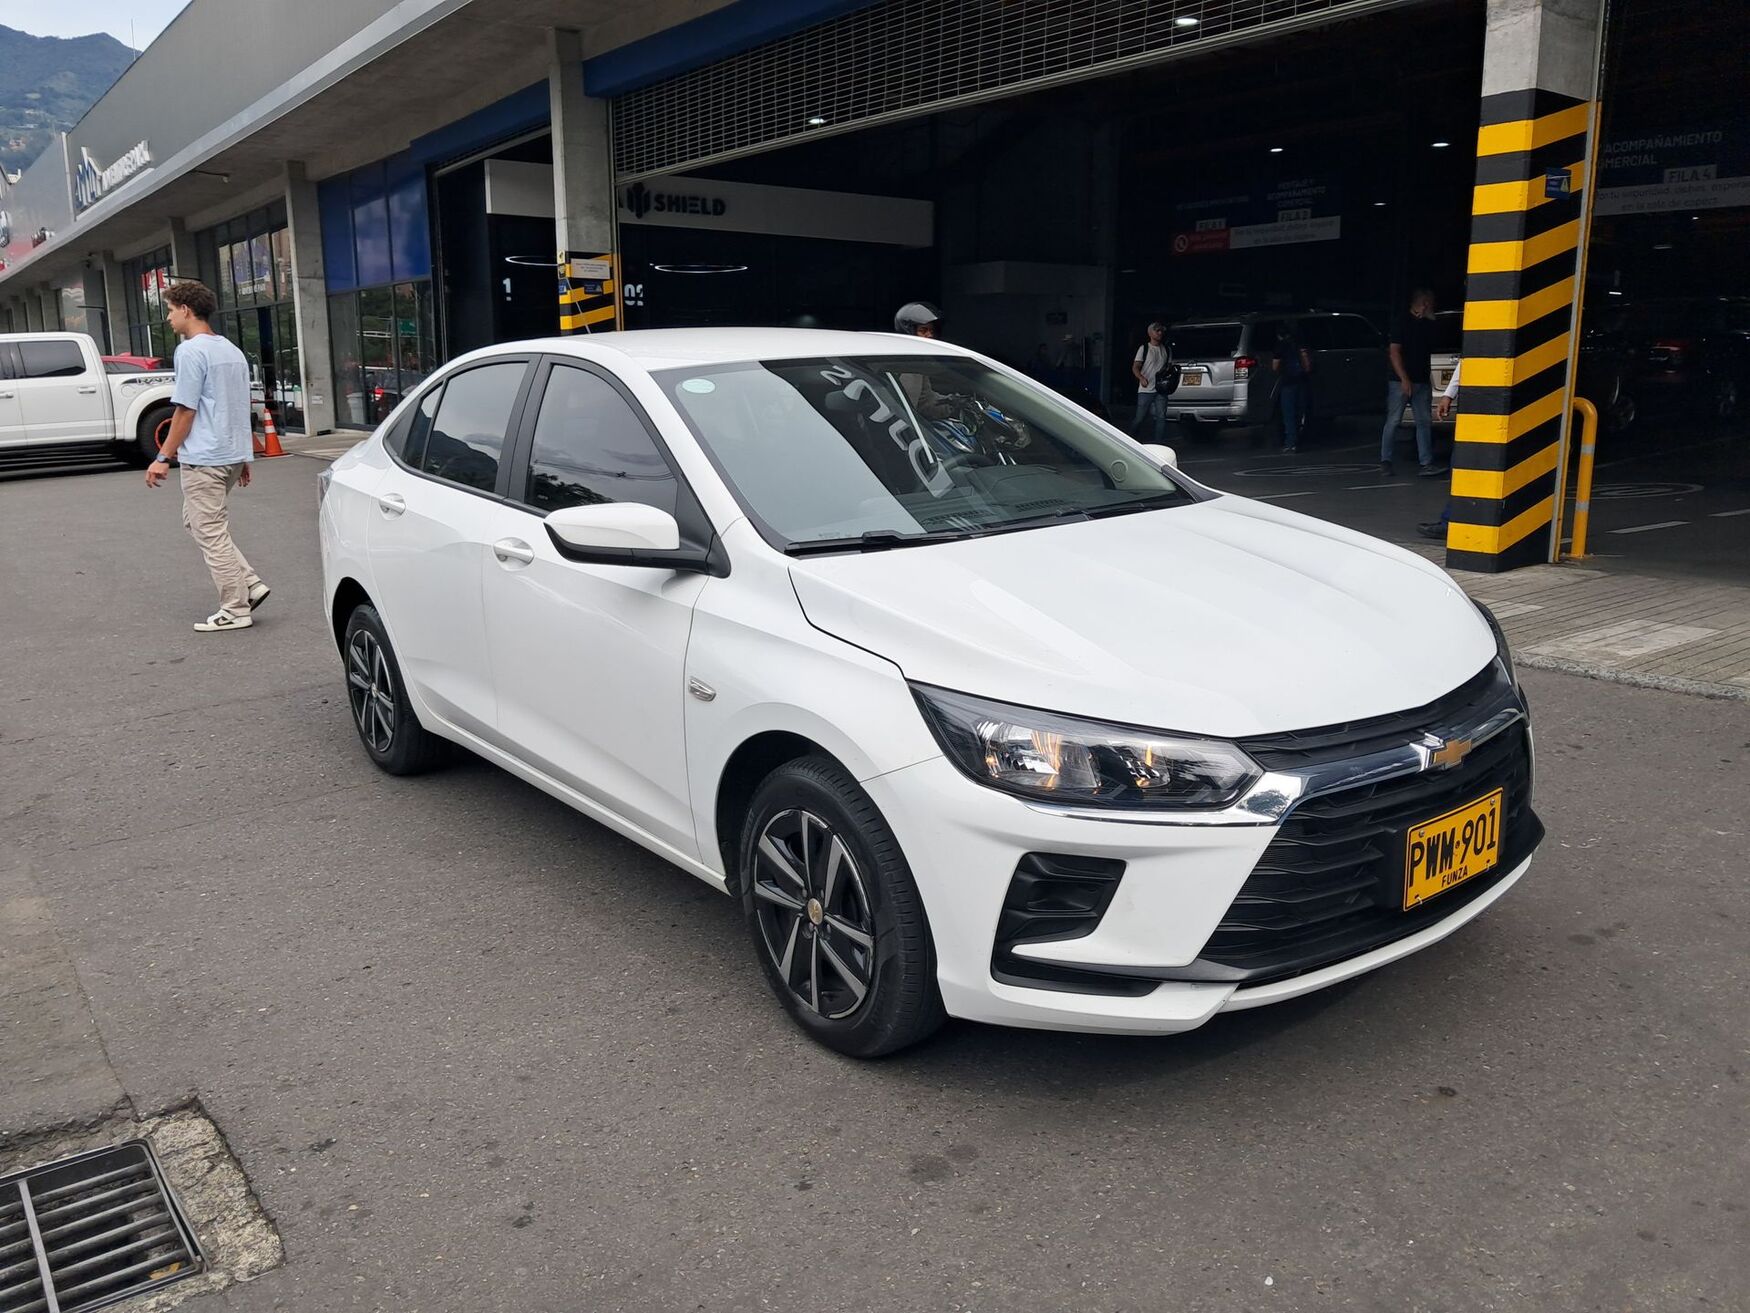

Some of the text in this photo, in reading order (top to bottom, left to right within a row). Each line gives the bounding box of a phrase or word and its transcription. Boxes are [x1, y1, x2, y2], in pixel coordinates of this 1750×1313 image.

[1669, 170, 1700, 183] FILA
[654, 194, 726, 216] SHIELD
[1441, 865, 1469, 888] FUNZA
